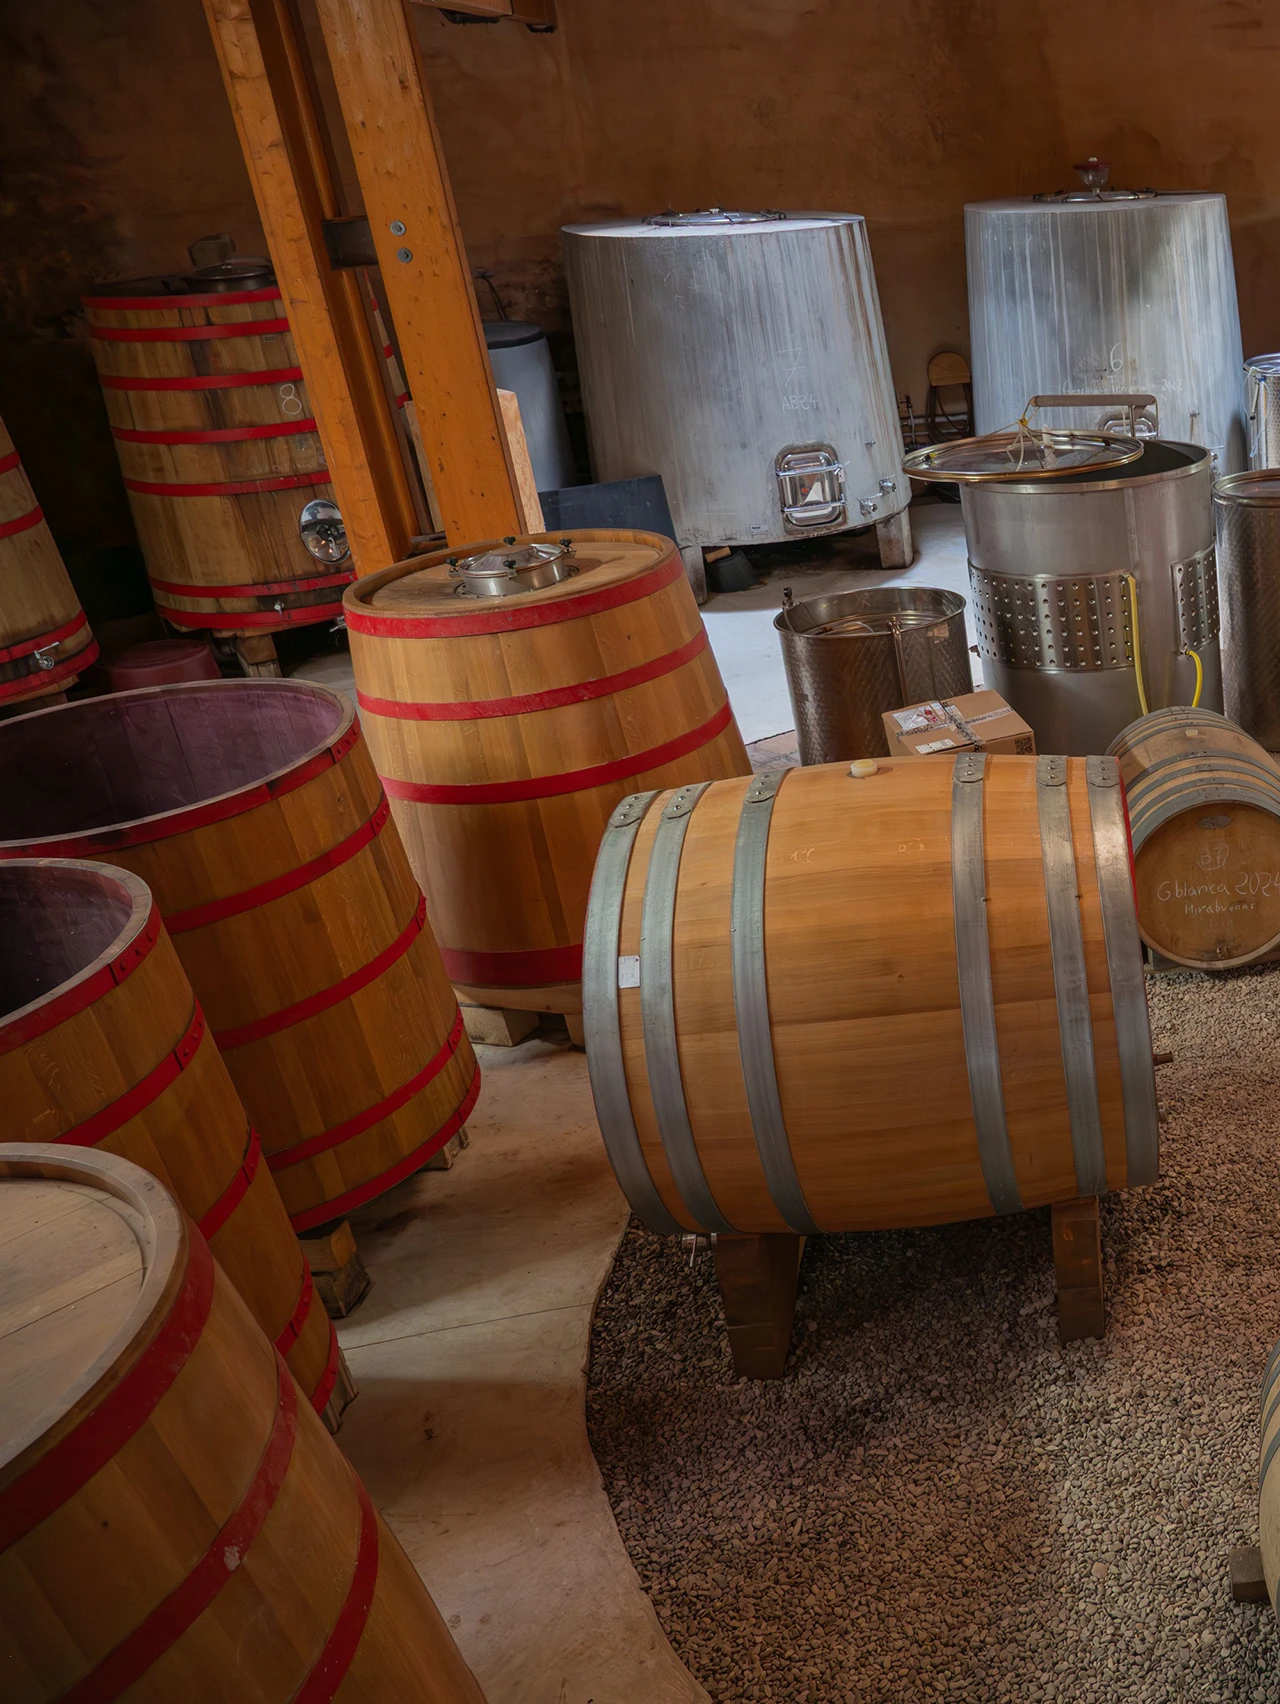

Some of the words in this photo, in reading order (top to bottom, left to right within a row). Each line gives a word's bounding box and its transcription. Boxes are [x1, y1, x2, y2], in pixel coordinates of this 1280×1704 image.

[778, 347, 805, 388] 7
[1110, 342, 1122, 372] 6
[280, 383, 302, 415] 8
